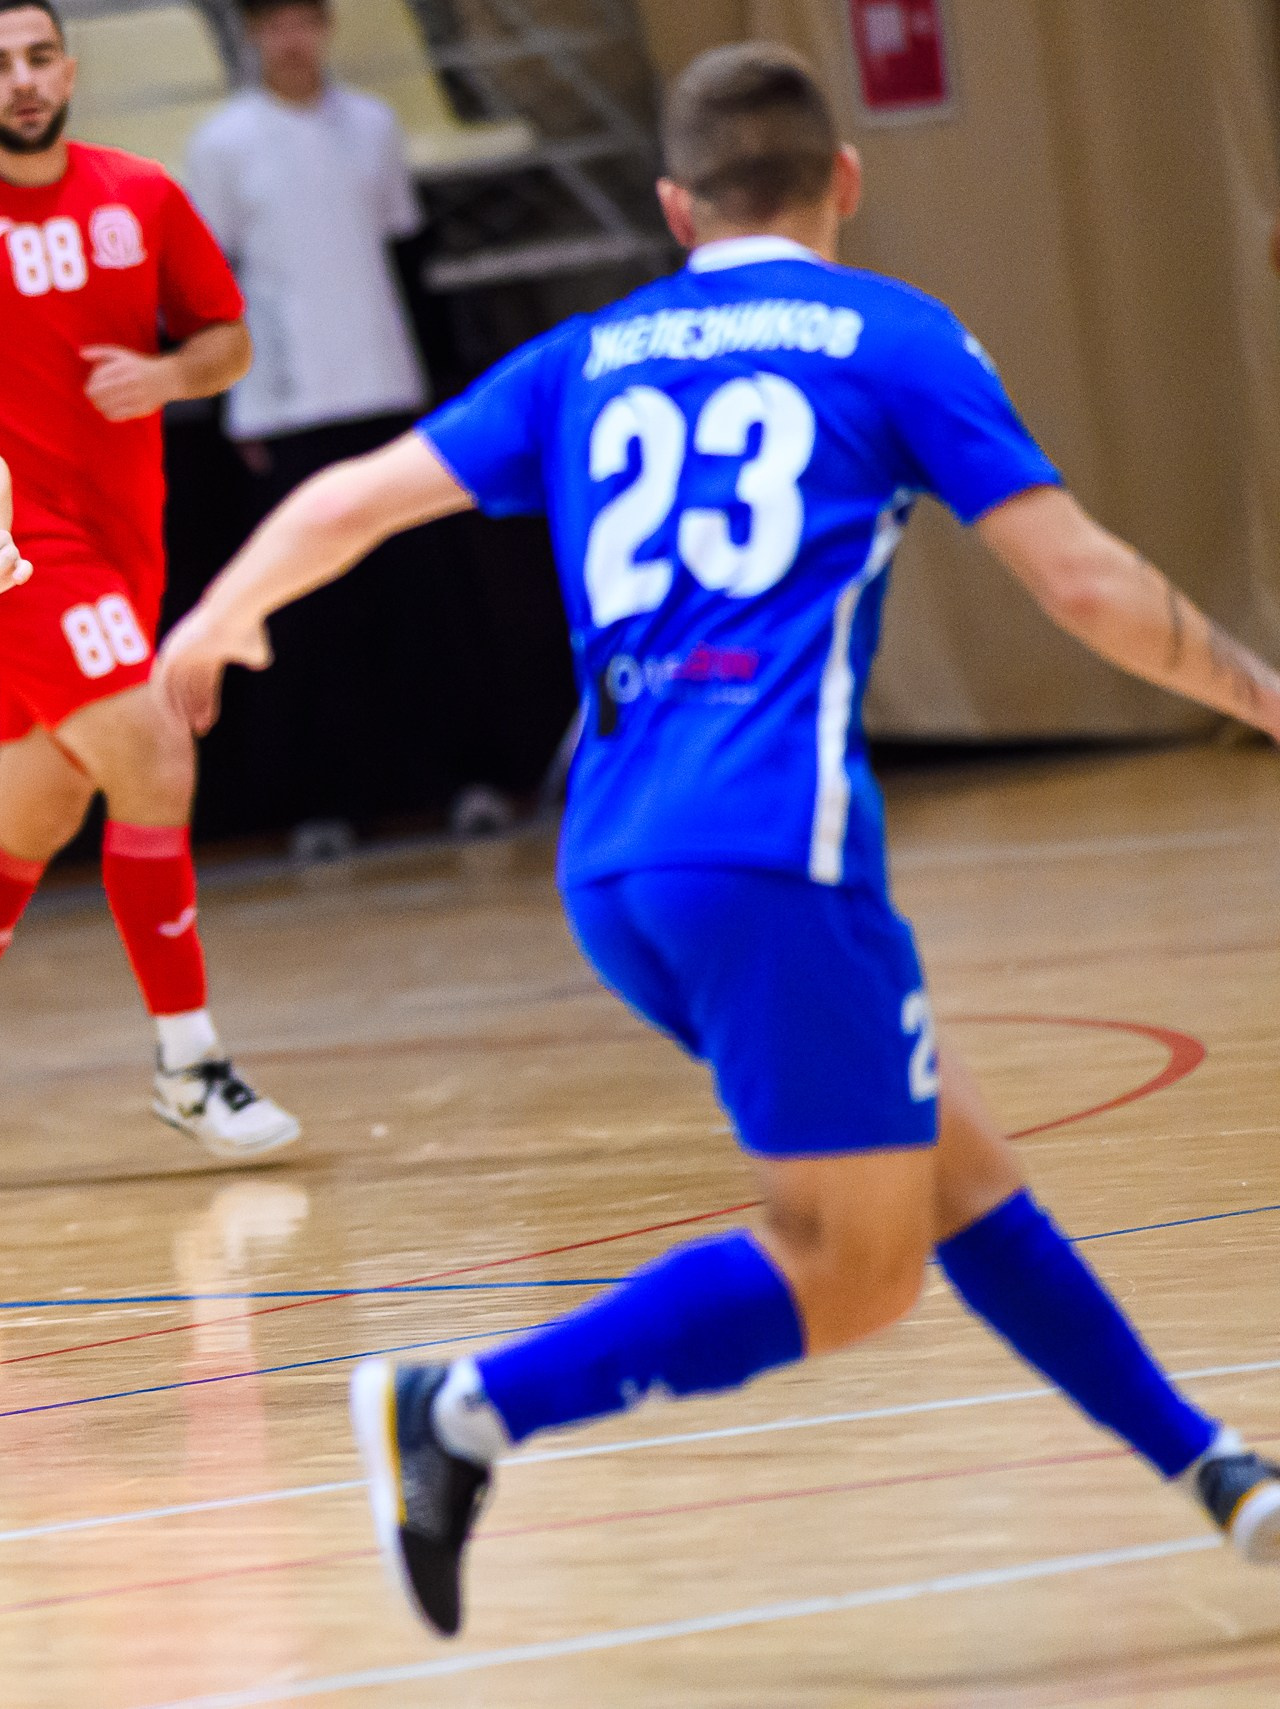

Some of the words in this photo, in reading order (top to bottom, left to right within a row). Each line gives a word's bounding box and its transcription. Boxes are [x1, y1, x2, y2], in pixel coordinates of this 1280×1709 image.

[5, 215, 89, 296] 88
[584, 371, 816, 629] 23
[60, 592, 150, 680] 88
